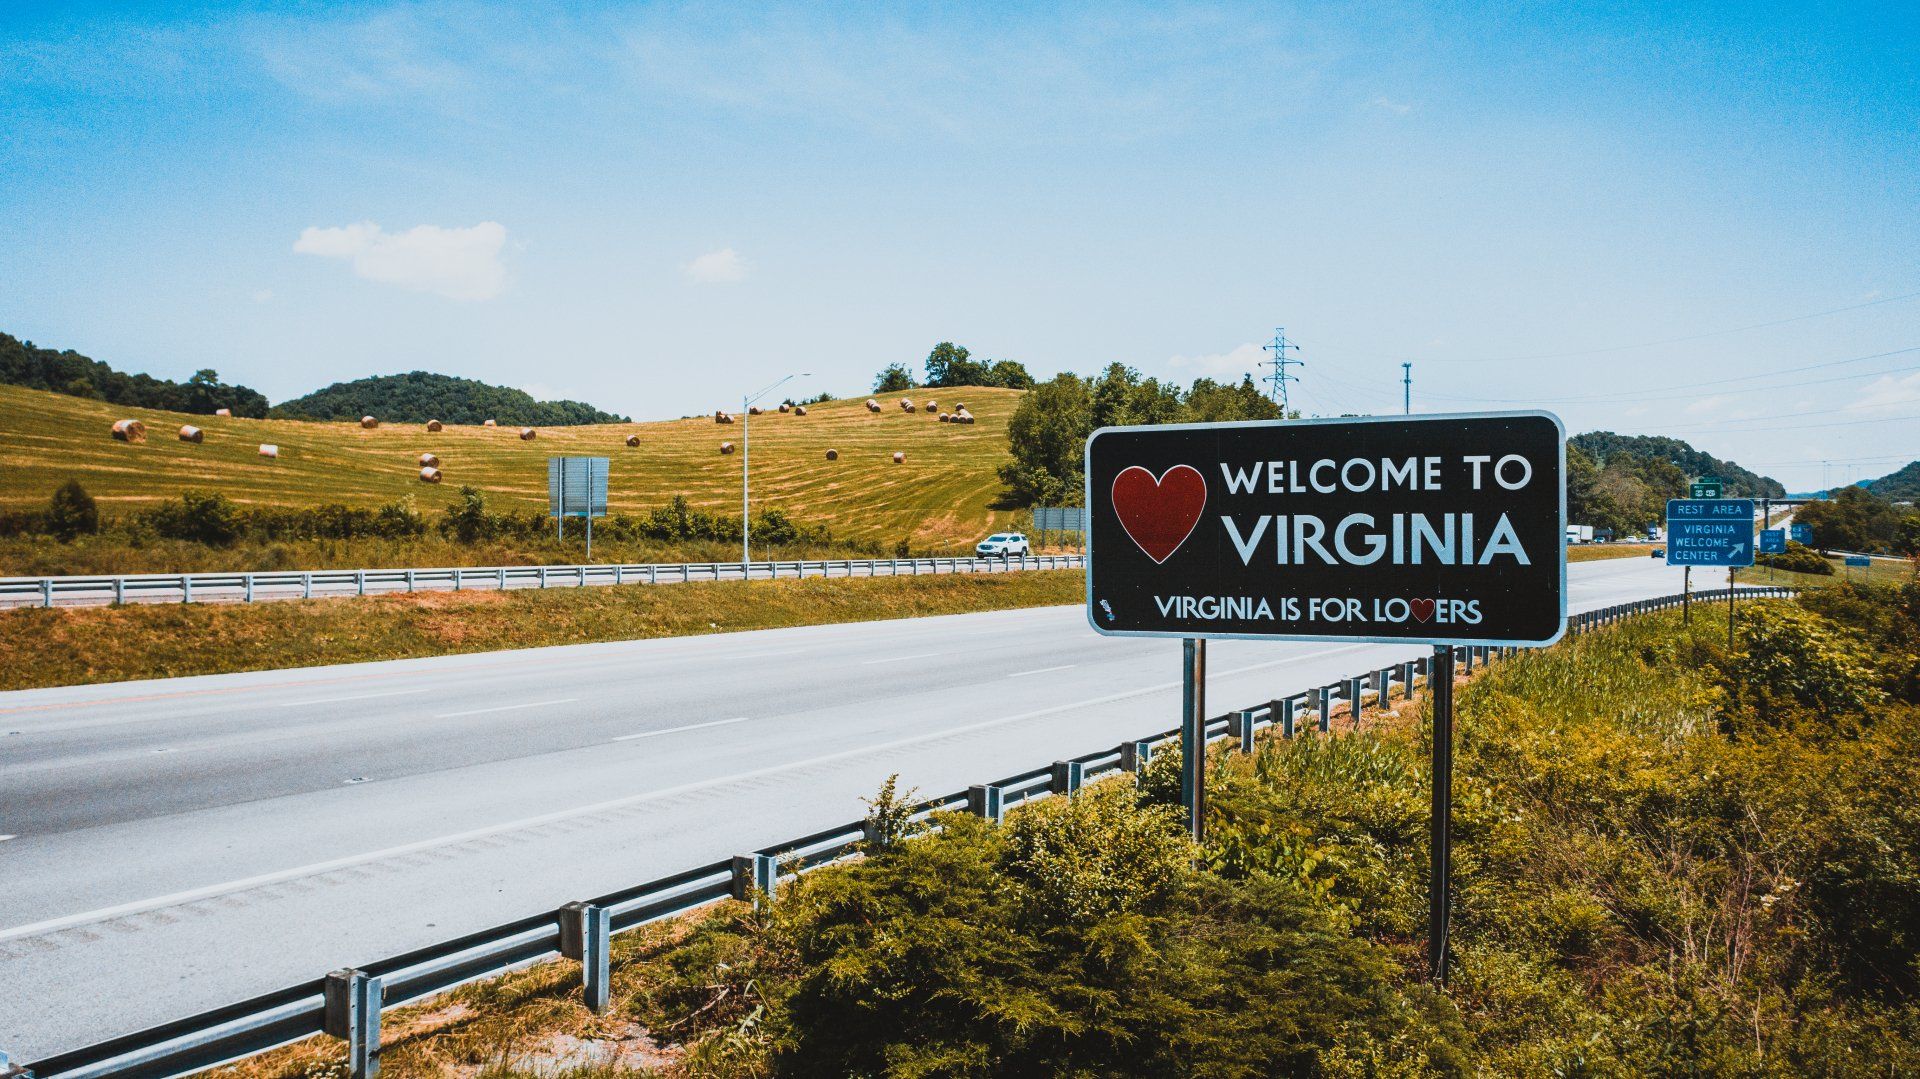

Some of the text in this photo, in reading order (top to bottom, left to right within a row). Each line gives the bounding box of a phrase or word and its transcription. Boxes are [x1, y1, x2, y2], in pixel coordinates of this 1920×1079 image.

[1219, 454, 1533, 495] WELCOME TO
[1678, 505, 1742, 514] REST AREA
[1684, 525, 1736, 534] VIRGINIA
[1220, 512, 1532, 566] VIRGINIA
[1675, 537, 1729, 547] WELCOME
[1675, 550, 1718, 561] CENTER
[1153, 595, 1275, 620] VIRGINIA
[1280, 597, 1301, 621] IS
[1309, 597, 1368, 622] FOR
